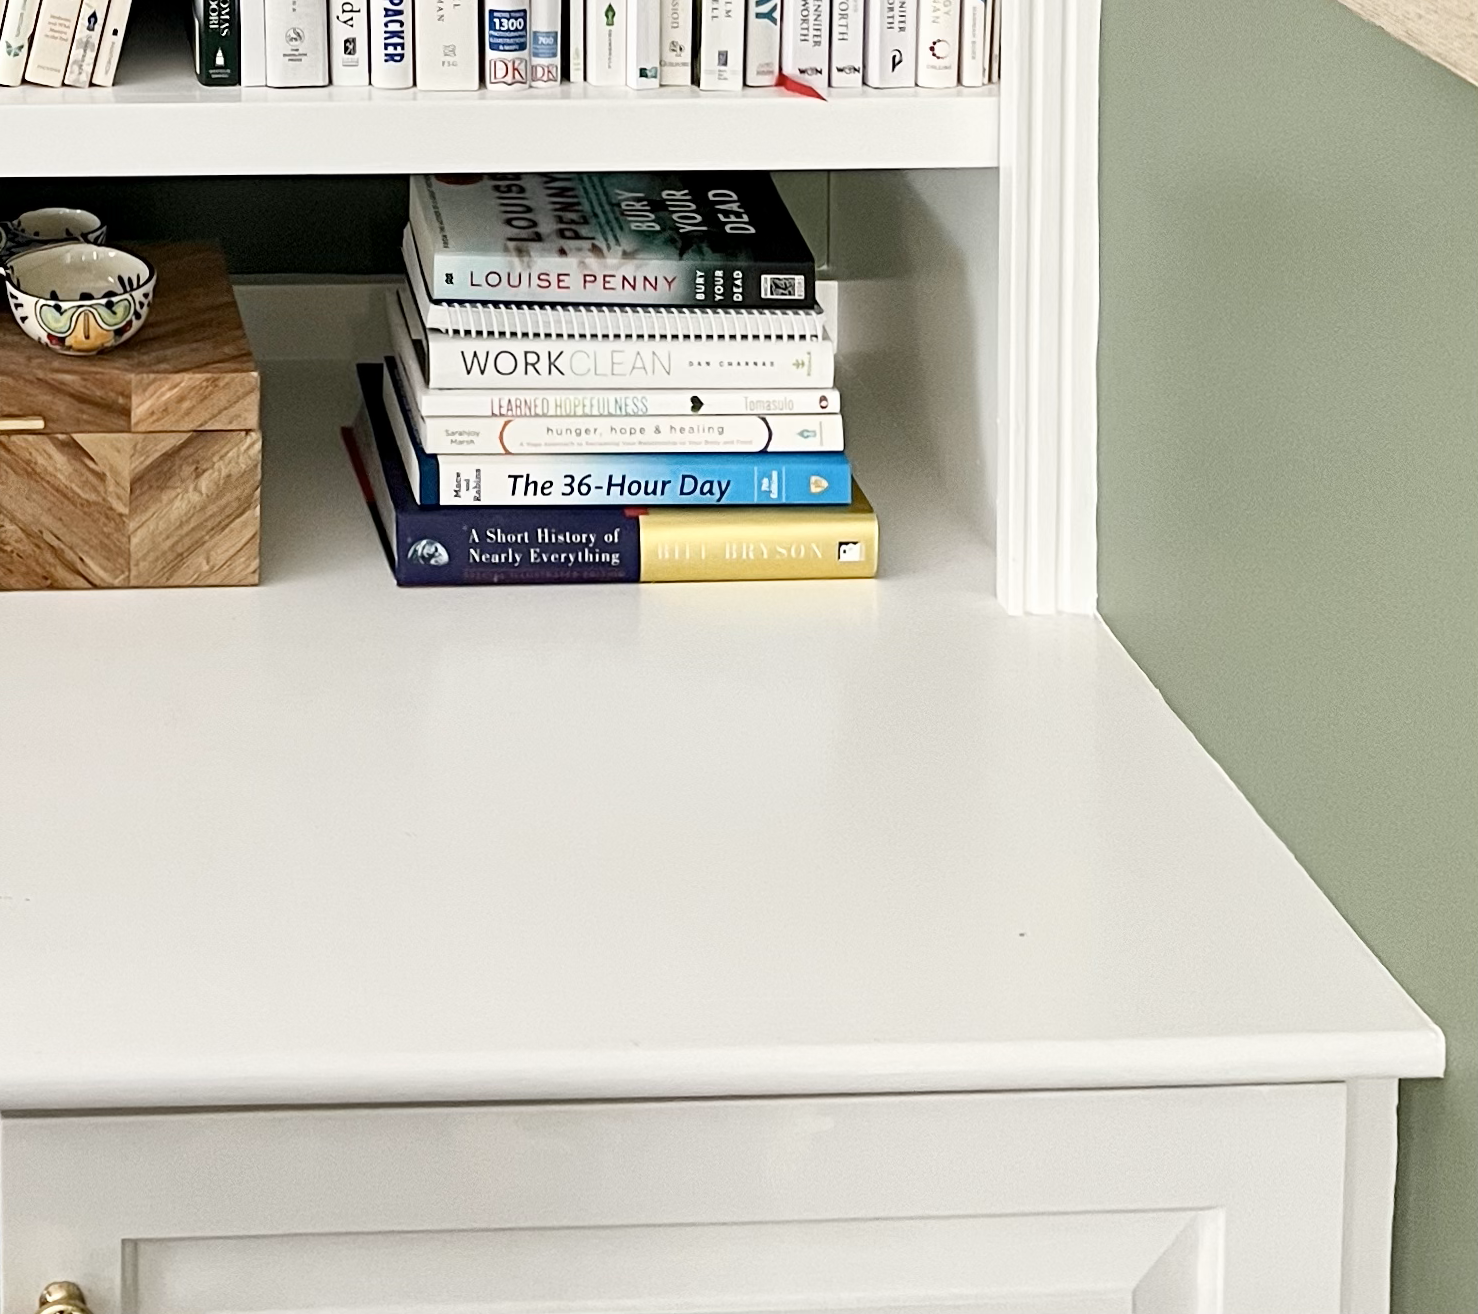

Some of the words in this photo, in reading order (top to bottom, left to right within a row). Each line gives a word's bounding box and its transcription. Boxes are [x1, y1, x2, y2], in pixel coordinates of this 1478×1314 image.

[469, 271, 570, 289] LOUISE
[583, 274, 677, 292] PENNY
[508, 474, 554, 497] The
[562, 475, 672, 497] 36-Hour
[679, 474, 731, 501] Day
[468, 529, 480, 543] A
[486, 528, 529, 544] Short
[538, 529, 597, 546] History
[603, 528, 620, 543] of
[469, 549, 523, 567] Nearly
[529, 548, 620, 567] Everything
